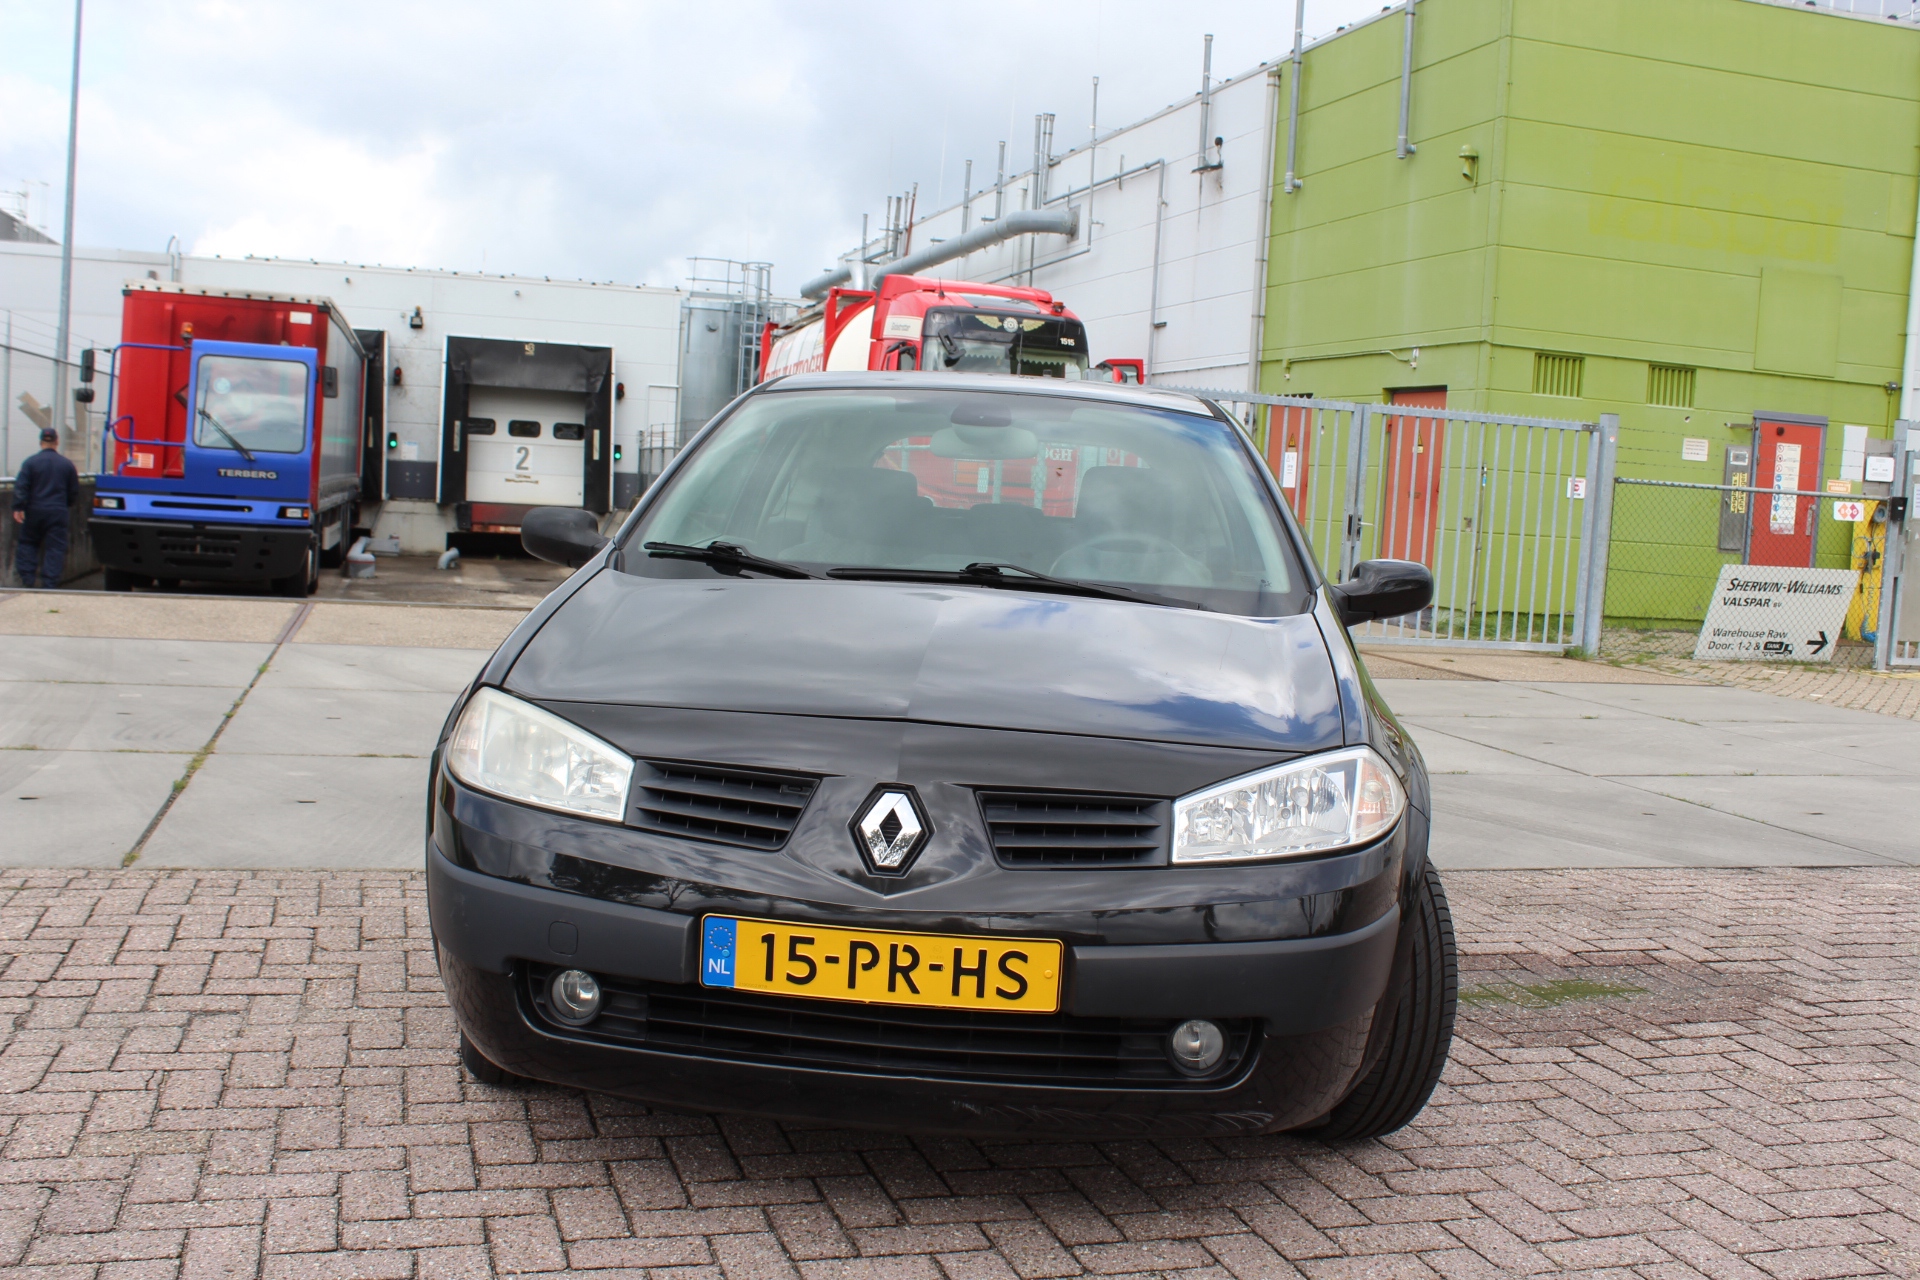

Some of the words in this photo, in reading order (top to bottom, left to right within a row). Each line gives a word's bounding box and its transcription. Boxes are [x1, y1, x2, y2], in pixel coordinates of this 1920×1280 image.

[1059, 337, 1075, 347] 1515
[515, 446, 530, 471] 2
[218, 468, 278, 480] TERBERG
[1722, 596, 1772, 608] VALSPAR
[1712, 628, 1765, 639] Warehouse
[1767, 629, 1788, 639] Raw
[1737, 641, 1751, 651] 1-2
[708, 958, 731, 975] NL
[761, 932, 1029, 1000] 15-PR-HS
